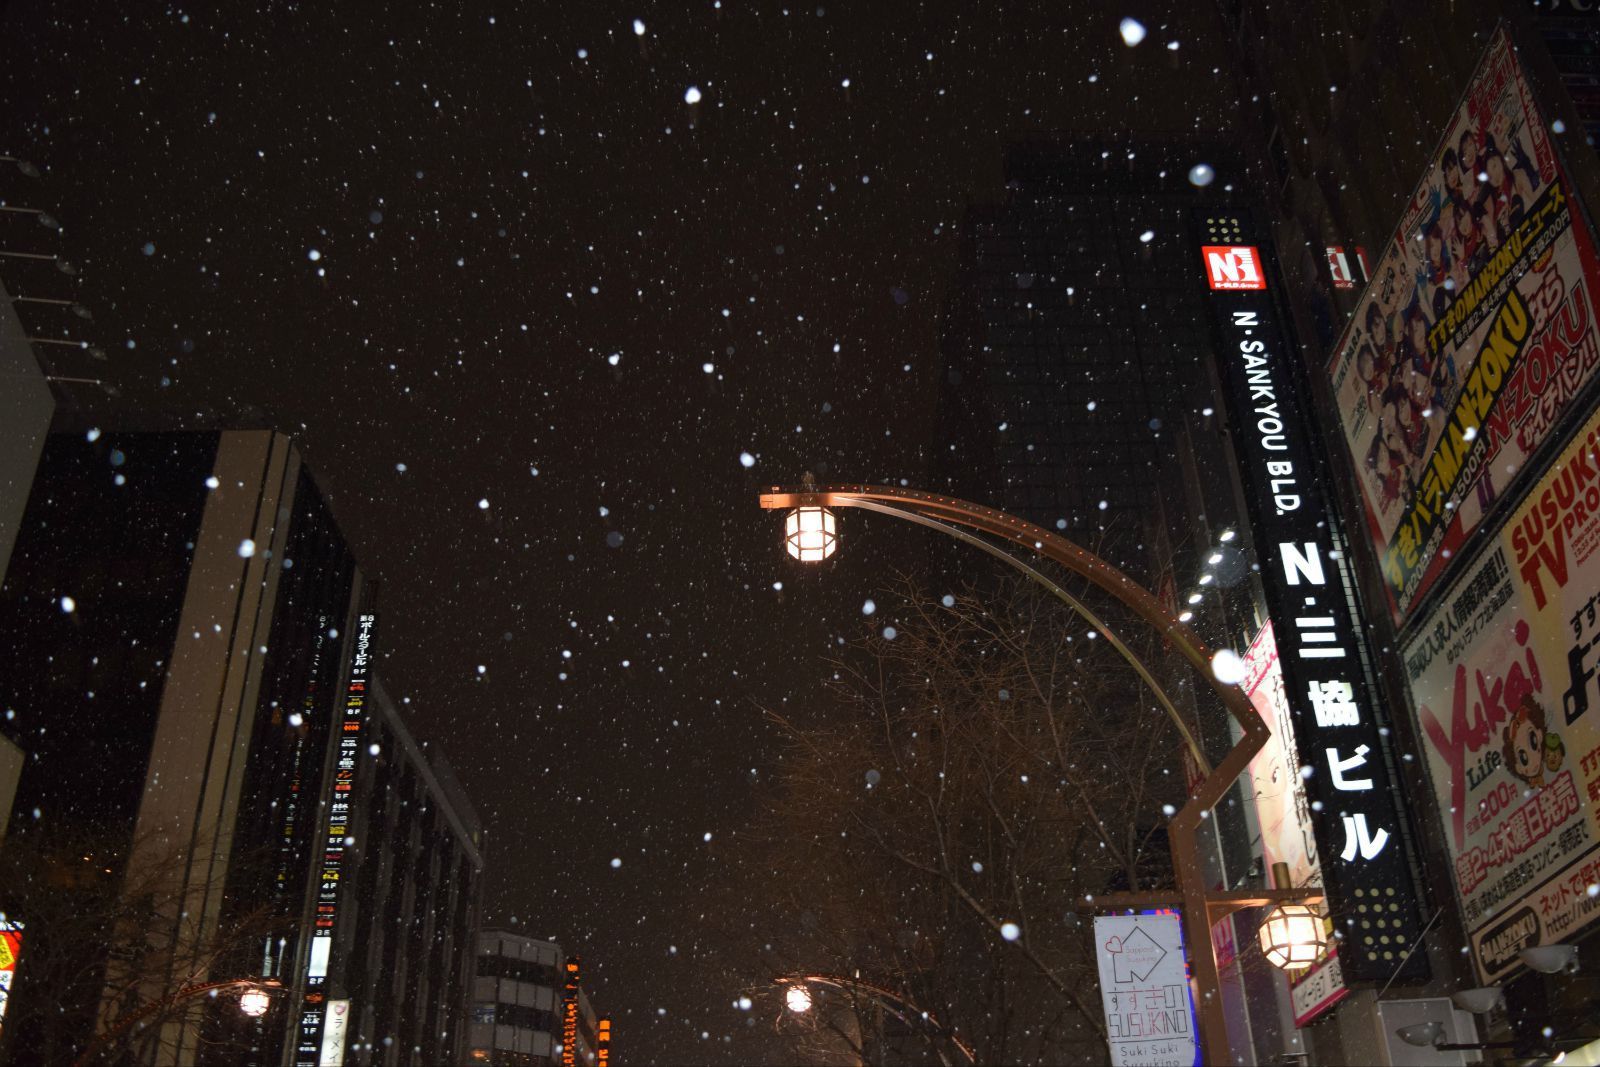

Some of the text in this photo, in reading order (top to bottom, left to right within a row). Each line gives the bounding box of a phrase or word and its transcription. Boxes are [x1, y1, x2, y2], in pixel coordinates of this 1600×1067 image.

[1483, 278, 1592, 463] N-ZOKU
[1267, 461, 1300, 516] BLD.
[1512, 424, 1600, 564] SUSUKi
[1520, 522, 1568, 612] TV
[1279, 542, 1388, 862] N・三協ビル
[1420, 619, 1542, 850] Yukai
[1466, 750, 1502, 791] Life
[1106, 985, 1185, 1012] すすきの
[1109, 1009, 1188, 1038] SUSUKINO
[1121, 1043, 1179, 1057] Suki Suki
